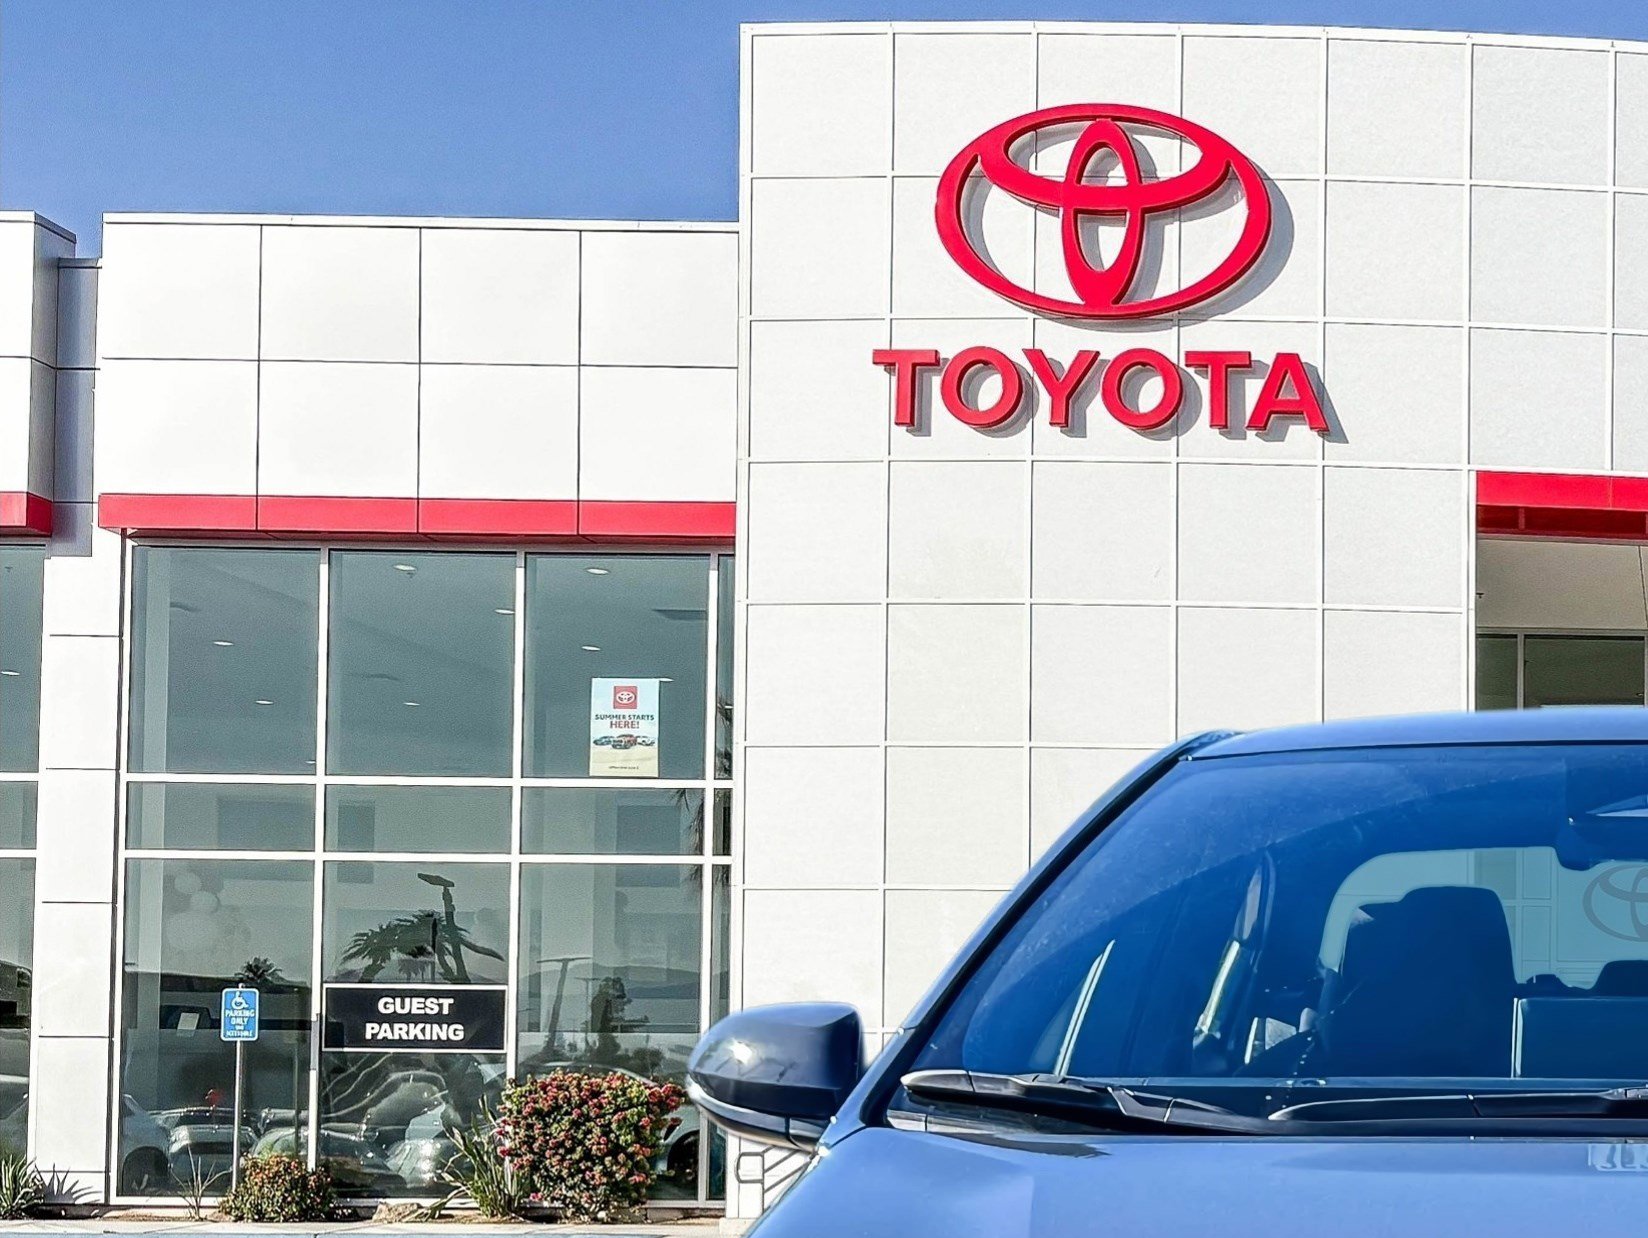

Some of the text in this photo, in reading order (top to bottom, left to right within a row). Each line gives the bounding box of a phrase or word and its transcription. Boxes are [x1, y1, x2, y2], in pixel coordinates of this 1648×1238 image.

[872, 345, 1331, 432] TOYOTA
[610, 720, 640, 729] HERE!
[377, 996, 454, 1015] GUEST
[365, 1022, 465, 1042] PARKING
